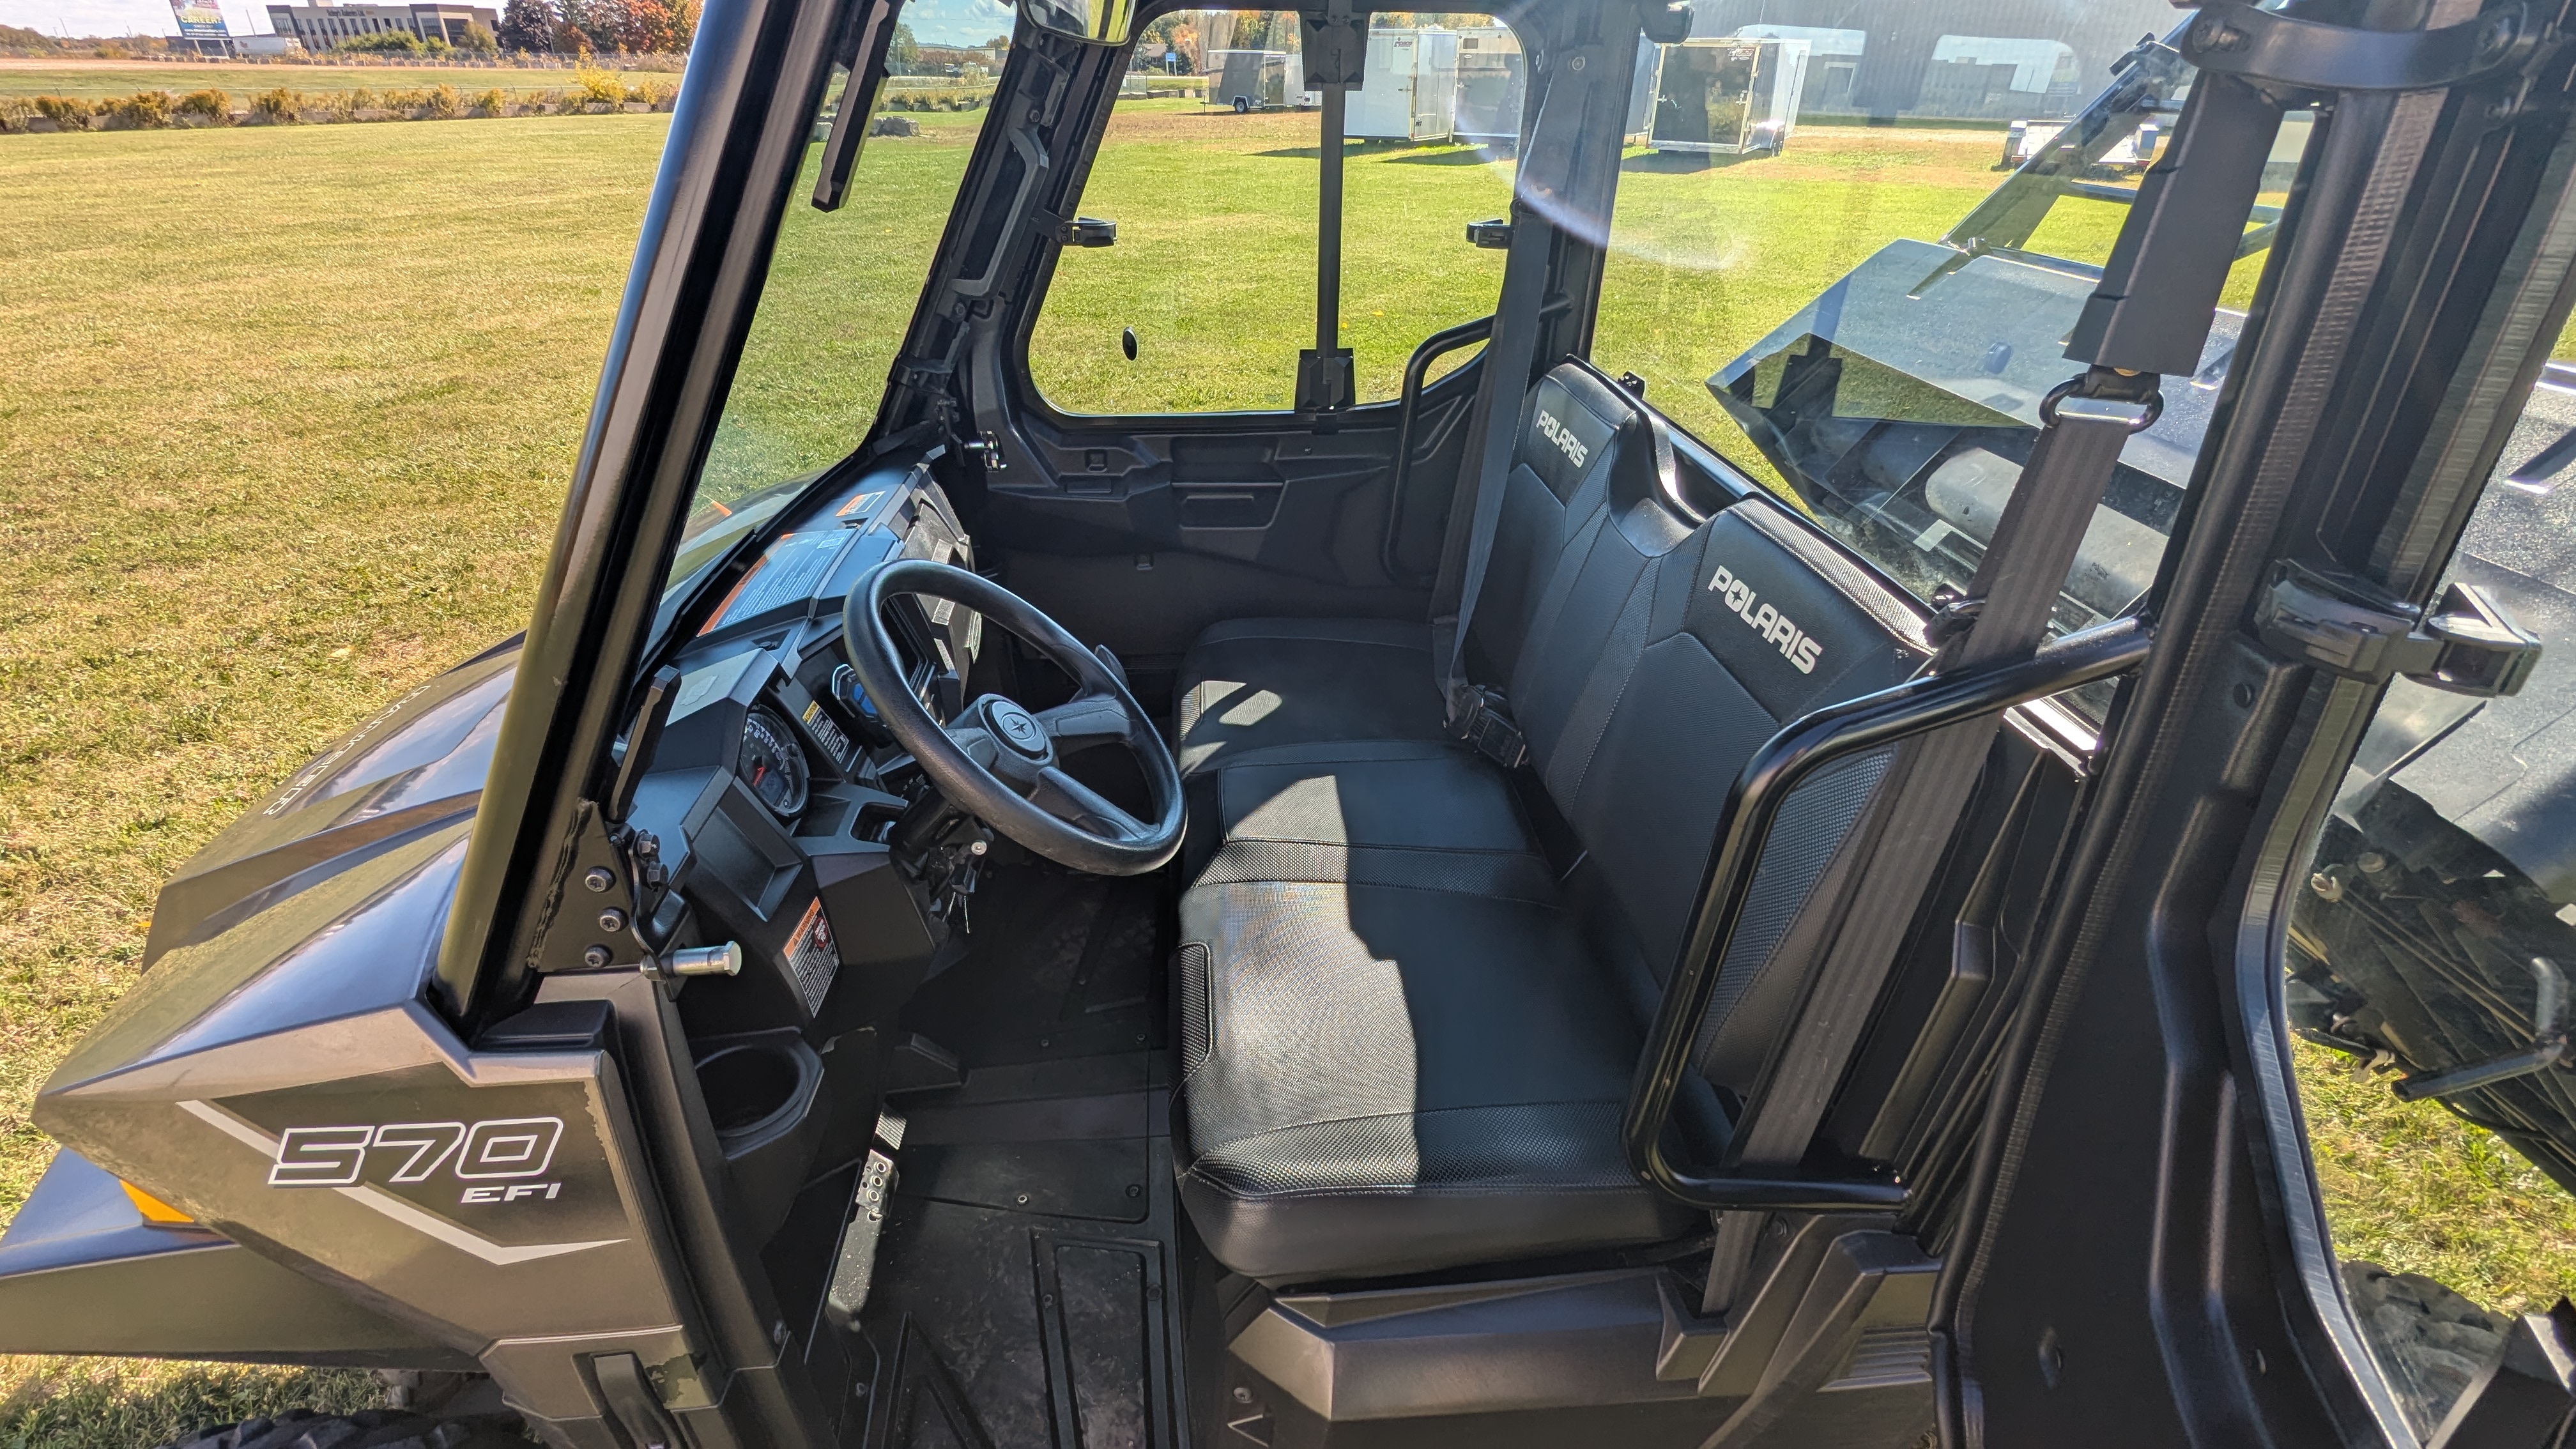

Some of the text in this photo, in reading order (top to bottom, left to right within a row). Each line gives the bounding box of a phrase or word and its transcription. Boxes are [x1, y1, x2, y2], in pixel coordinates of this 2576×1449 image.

[180, 15, 222, 24] CAREER?
[1535, 409, 1589, 469] POLARIS
[1708, 565, 1823, 675] POLARIS
[263, 685, 431, 815] RANGER
[795, 909, 815, 938] WARNING
[268, 1116, 564, 1185] 570
[460, 1182, 562, 1204] EFI
